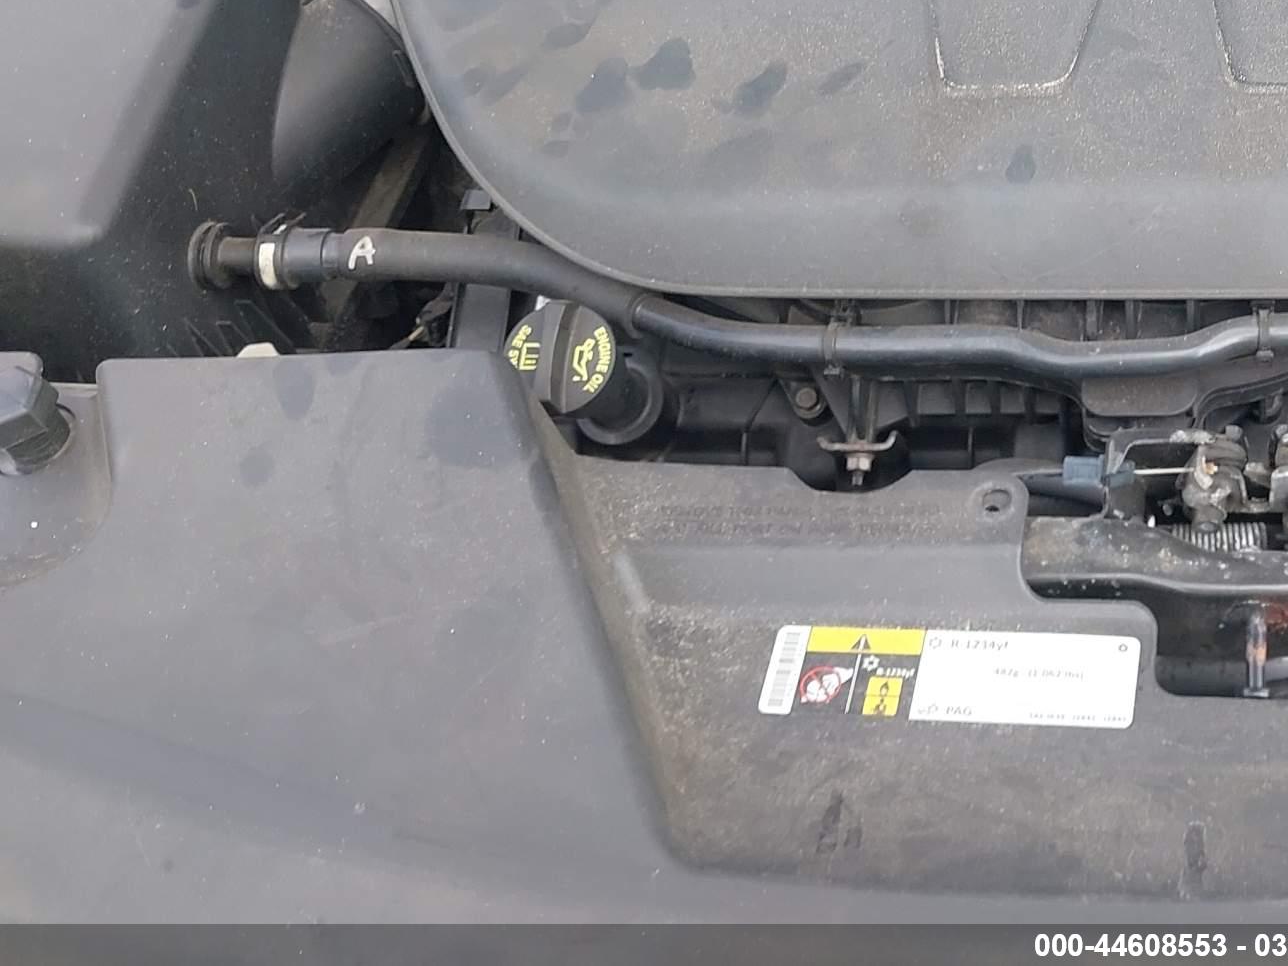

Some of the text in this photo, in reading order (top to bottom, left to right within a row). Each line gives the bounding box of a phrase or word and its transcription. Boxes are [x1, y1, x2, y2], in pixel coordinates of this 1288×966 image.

[348, 236, 377, 270] A
[582, 325, 611, 393] ENGINE OIL
